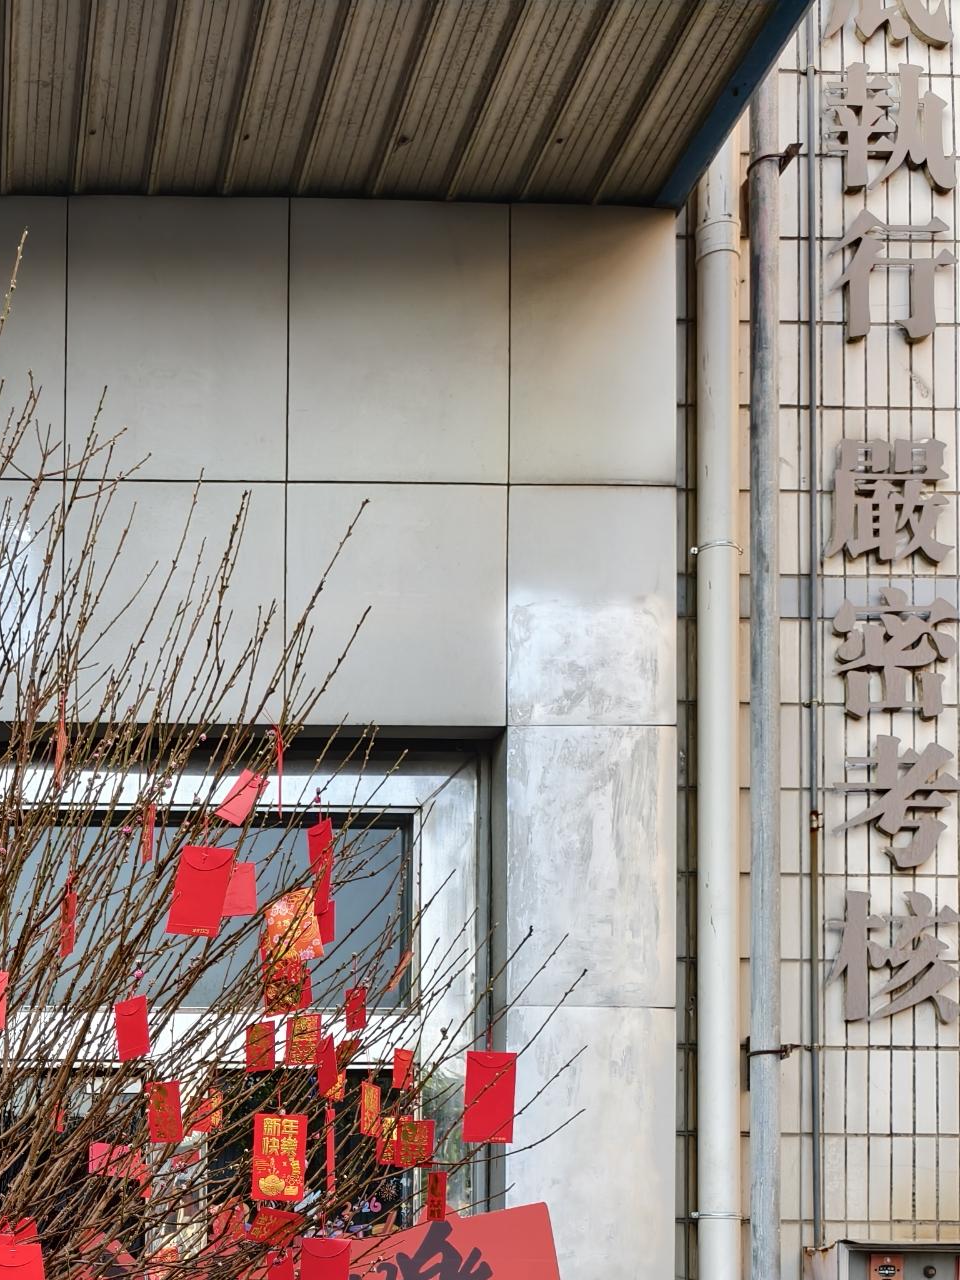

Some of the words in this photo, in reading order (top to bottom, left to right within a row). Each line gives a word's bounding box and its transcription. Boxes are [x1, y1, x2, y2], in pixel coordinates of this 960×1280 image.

[822, 438, 959, 1024] 嚴密考核
[263, 1118, 299, 1136] 新年
